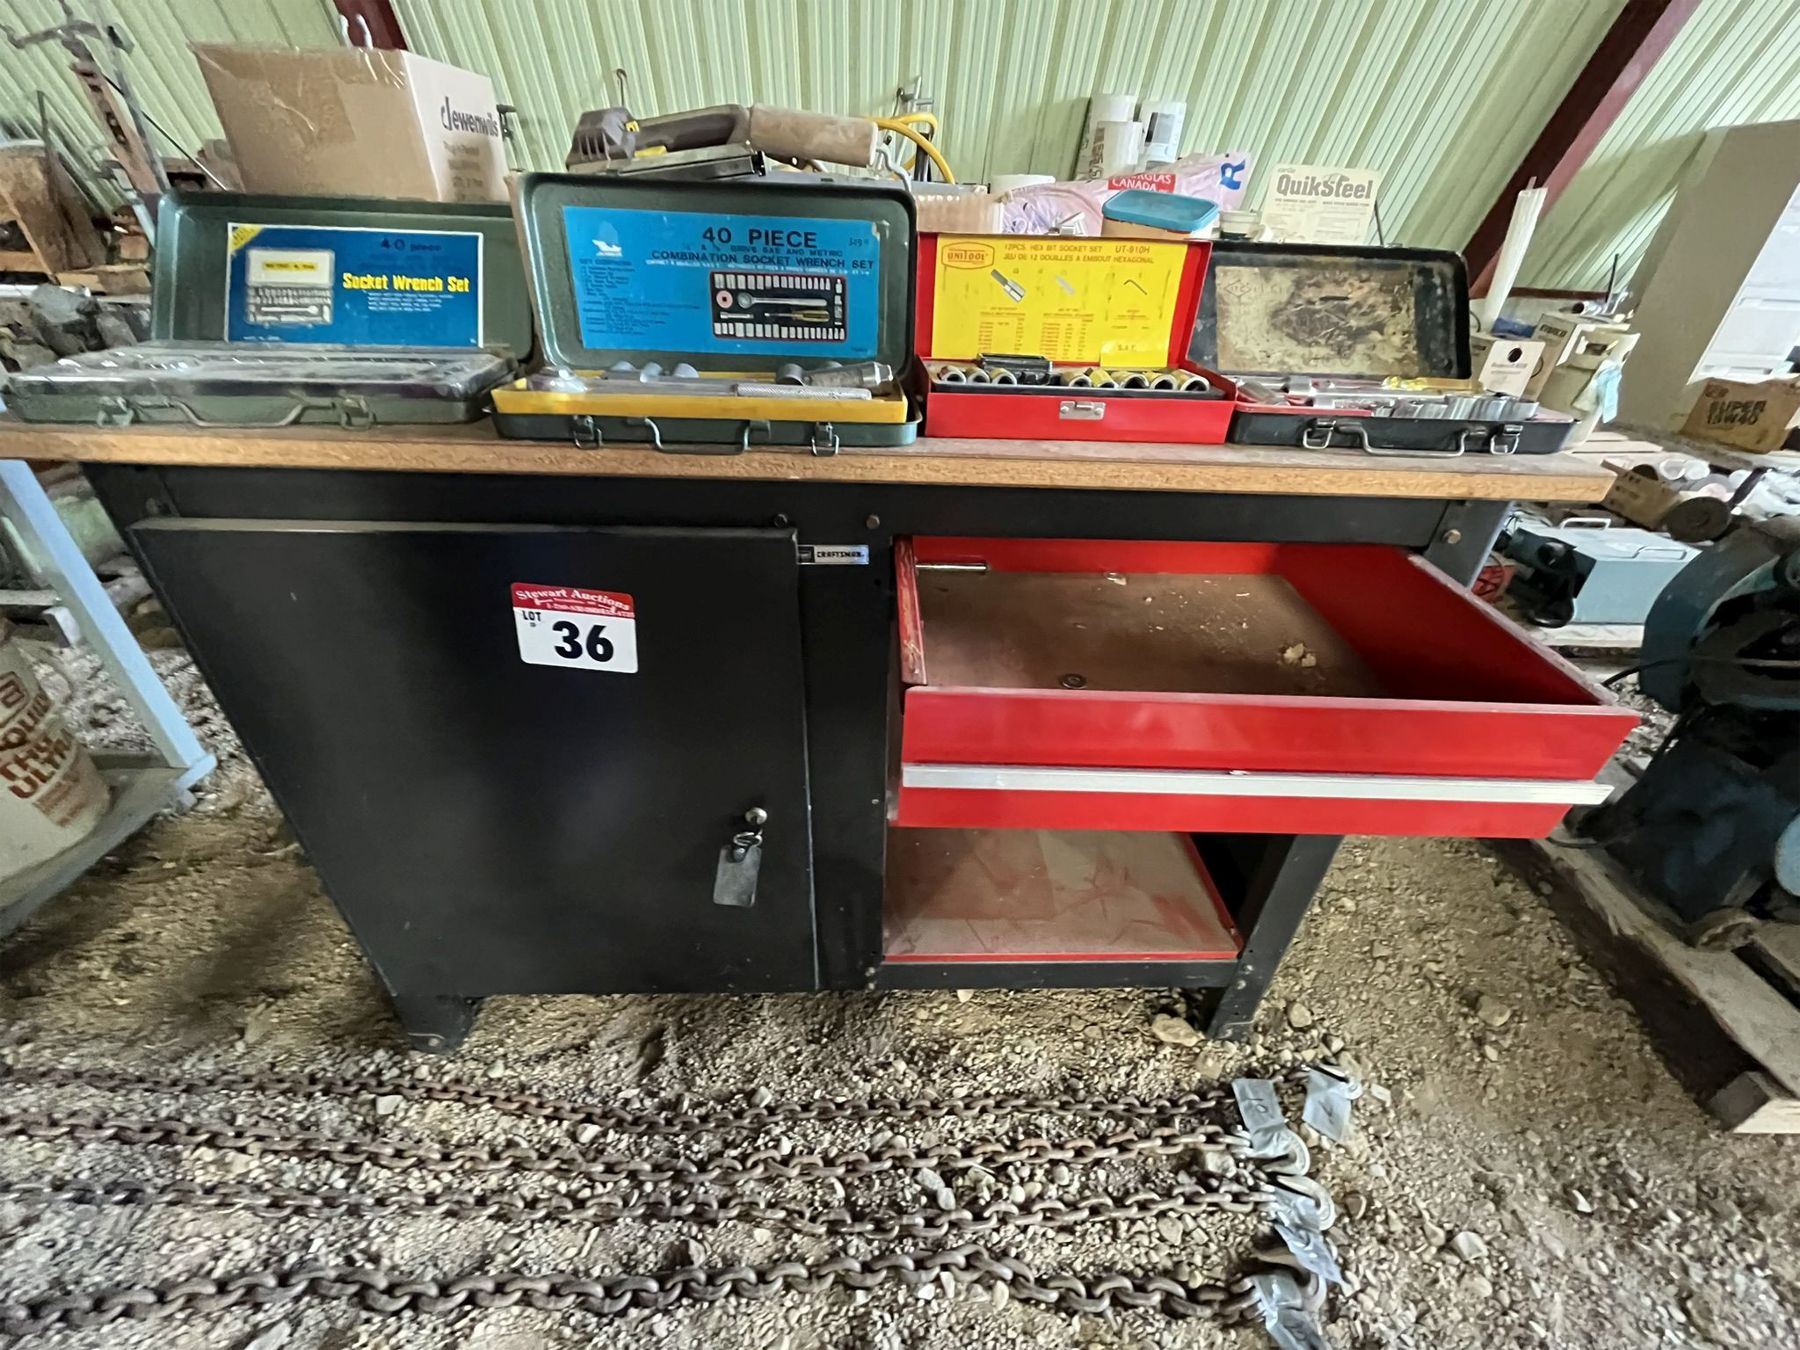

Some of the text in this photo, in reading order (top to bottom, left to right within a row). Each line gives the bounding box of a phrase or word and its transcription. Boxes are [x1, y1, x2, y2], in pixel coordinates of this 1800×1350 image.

[1111, 177, 1158, 192] CANADA
[1276, 173, 1374, 199] QuikSteel
[702, 226, 817, 249] 40 PIECE
[651, 250, 737, 264] COMBINATION
[743, 254, 791, 266] SOCKET
[795, 256, 846, 268] WRENCH
[851, 260, 875, 269] SET
[1060, 245, 1088, 253] SOCKET
[342, 272, 470, 293] Socket Wrench Set
[515, 588, 568, 601] Stewart
[571, 588, 631, 611] Auctions
[522, 610, 542, 622] LOT
[552, 620, 615, 663] 36
